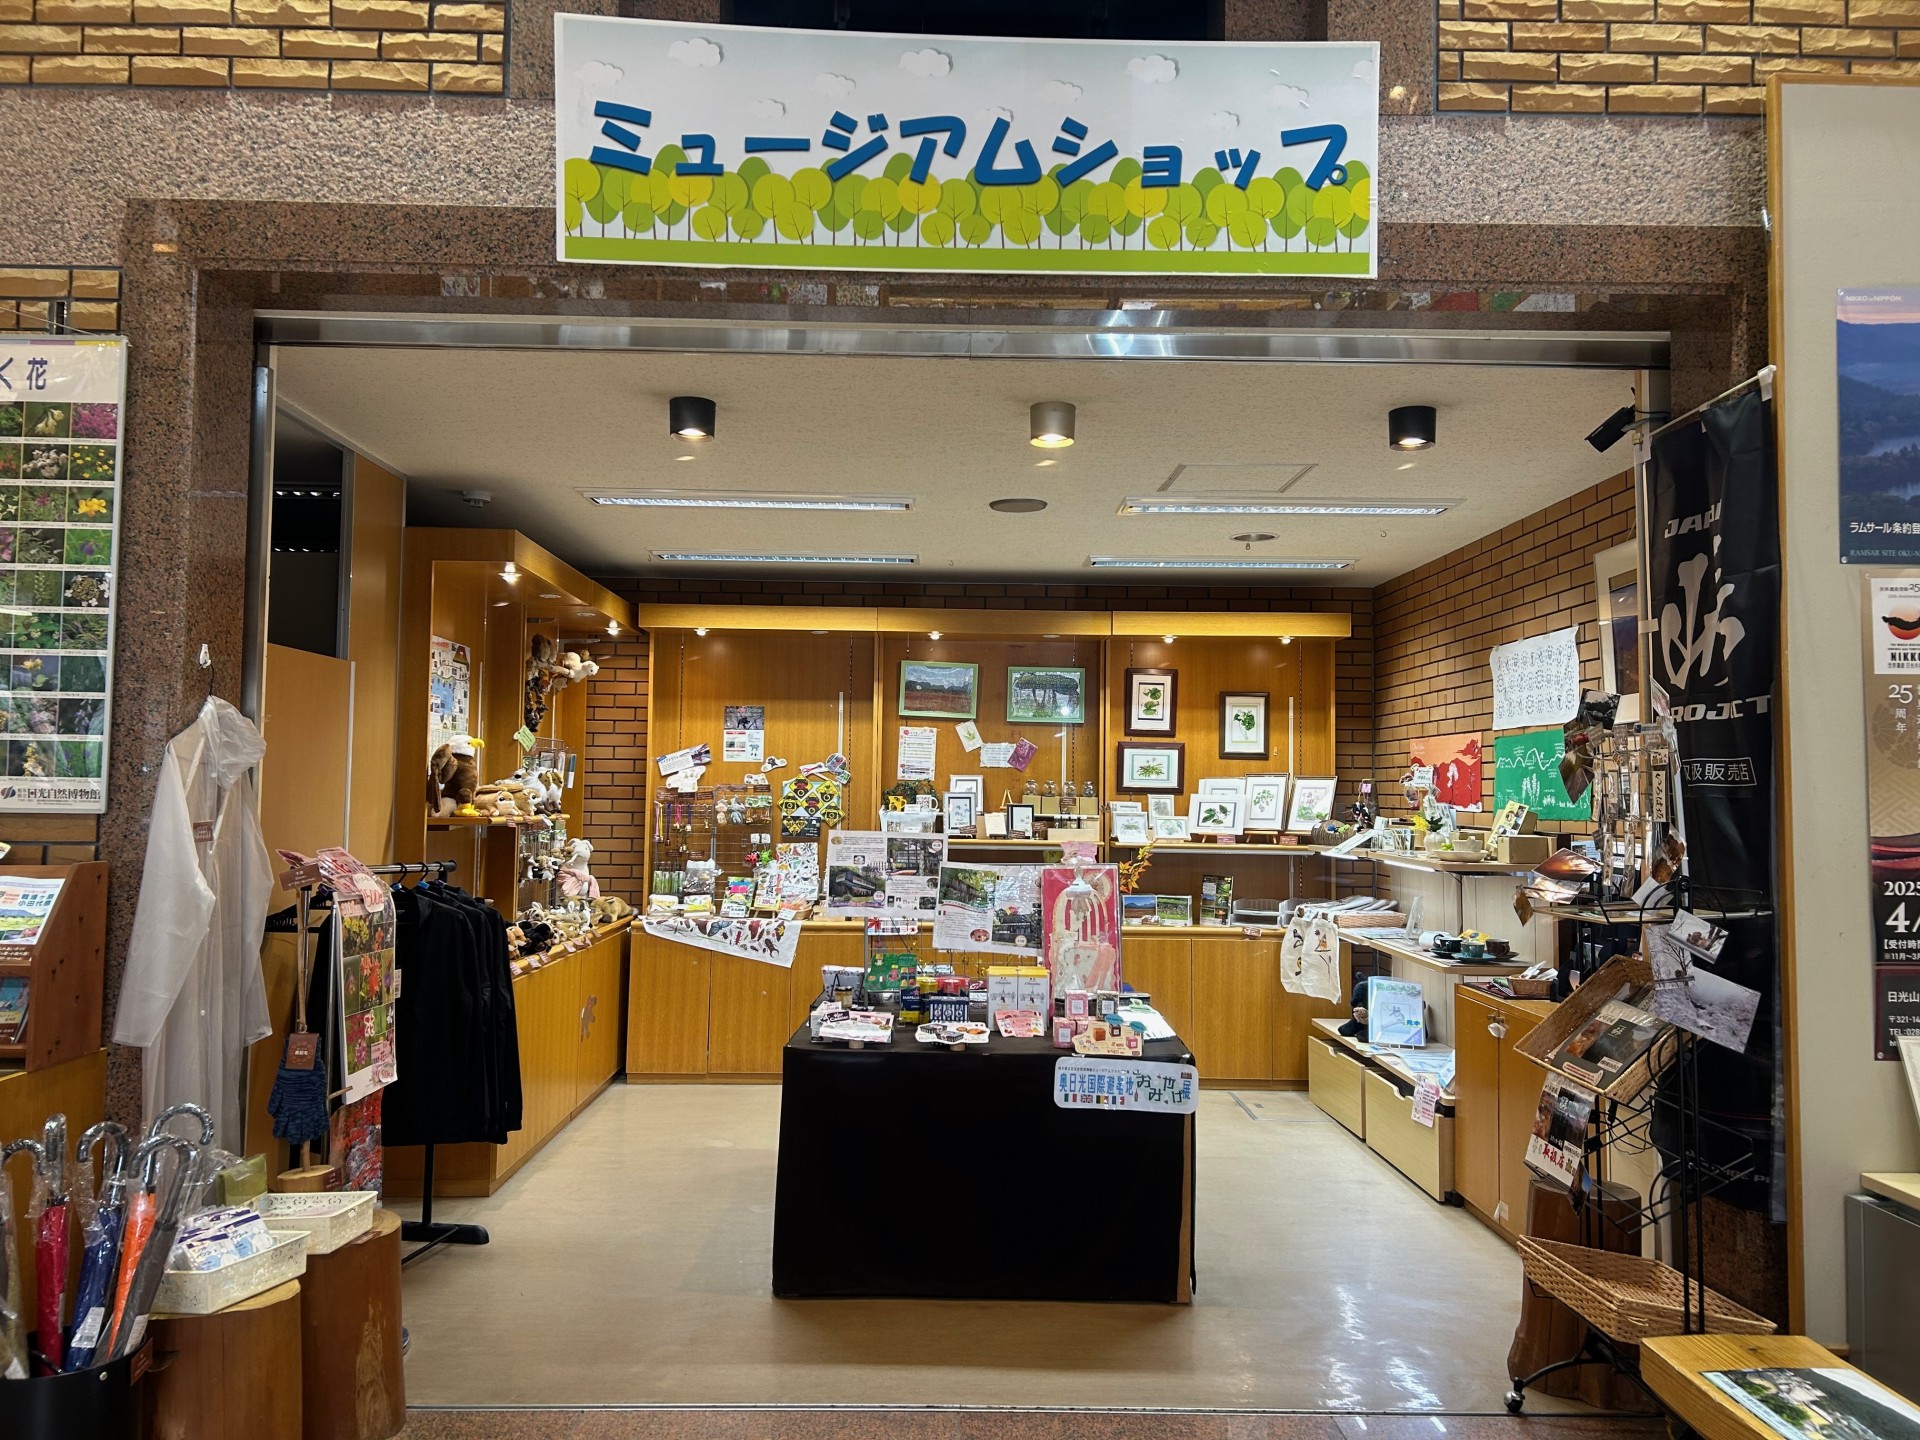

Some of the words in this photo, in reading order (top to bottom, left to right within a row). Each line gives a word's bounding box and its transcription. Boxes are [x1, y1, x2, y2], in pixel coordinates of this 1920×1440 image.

[590, 101, 1348, 191] ミュージアムショップ
[1850, 549, 1880, 557] RAMSAR
[1881, 549, 1897, 557] SITE
[1888, 684, 1914, 704] 25
[1887, 990, 1920, 1003] 日光山
